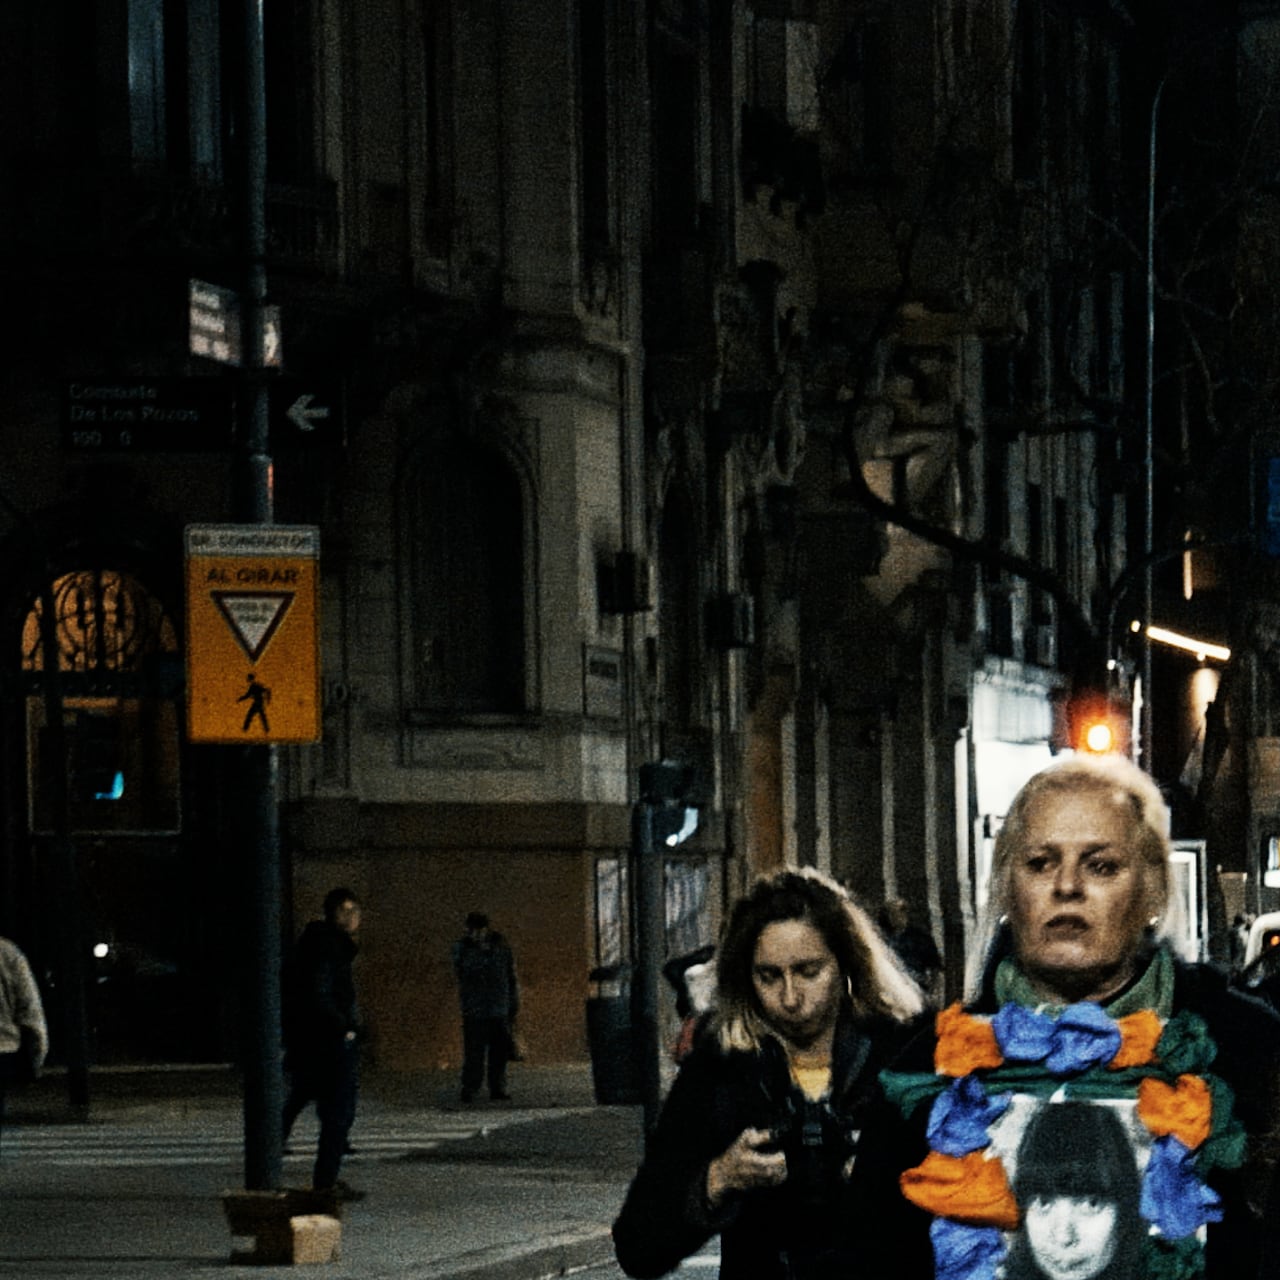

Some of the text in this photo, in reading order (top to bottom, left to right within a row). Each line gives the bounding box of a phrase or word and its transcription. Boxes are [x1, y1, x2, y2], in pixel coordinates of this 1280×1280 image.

[69, 405, 200, 423] De Los Pozos
[207, 568, 299, 584] AL GIRAR
